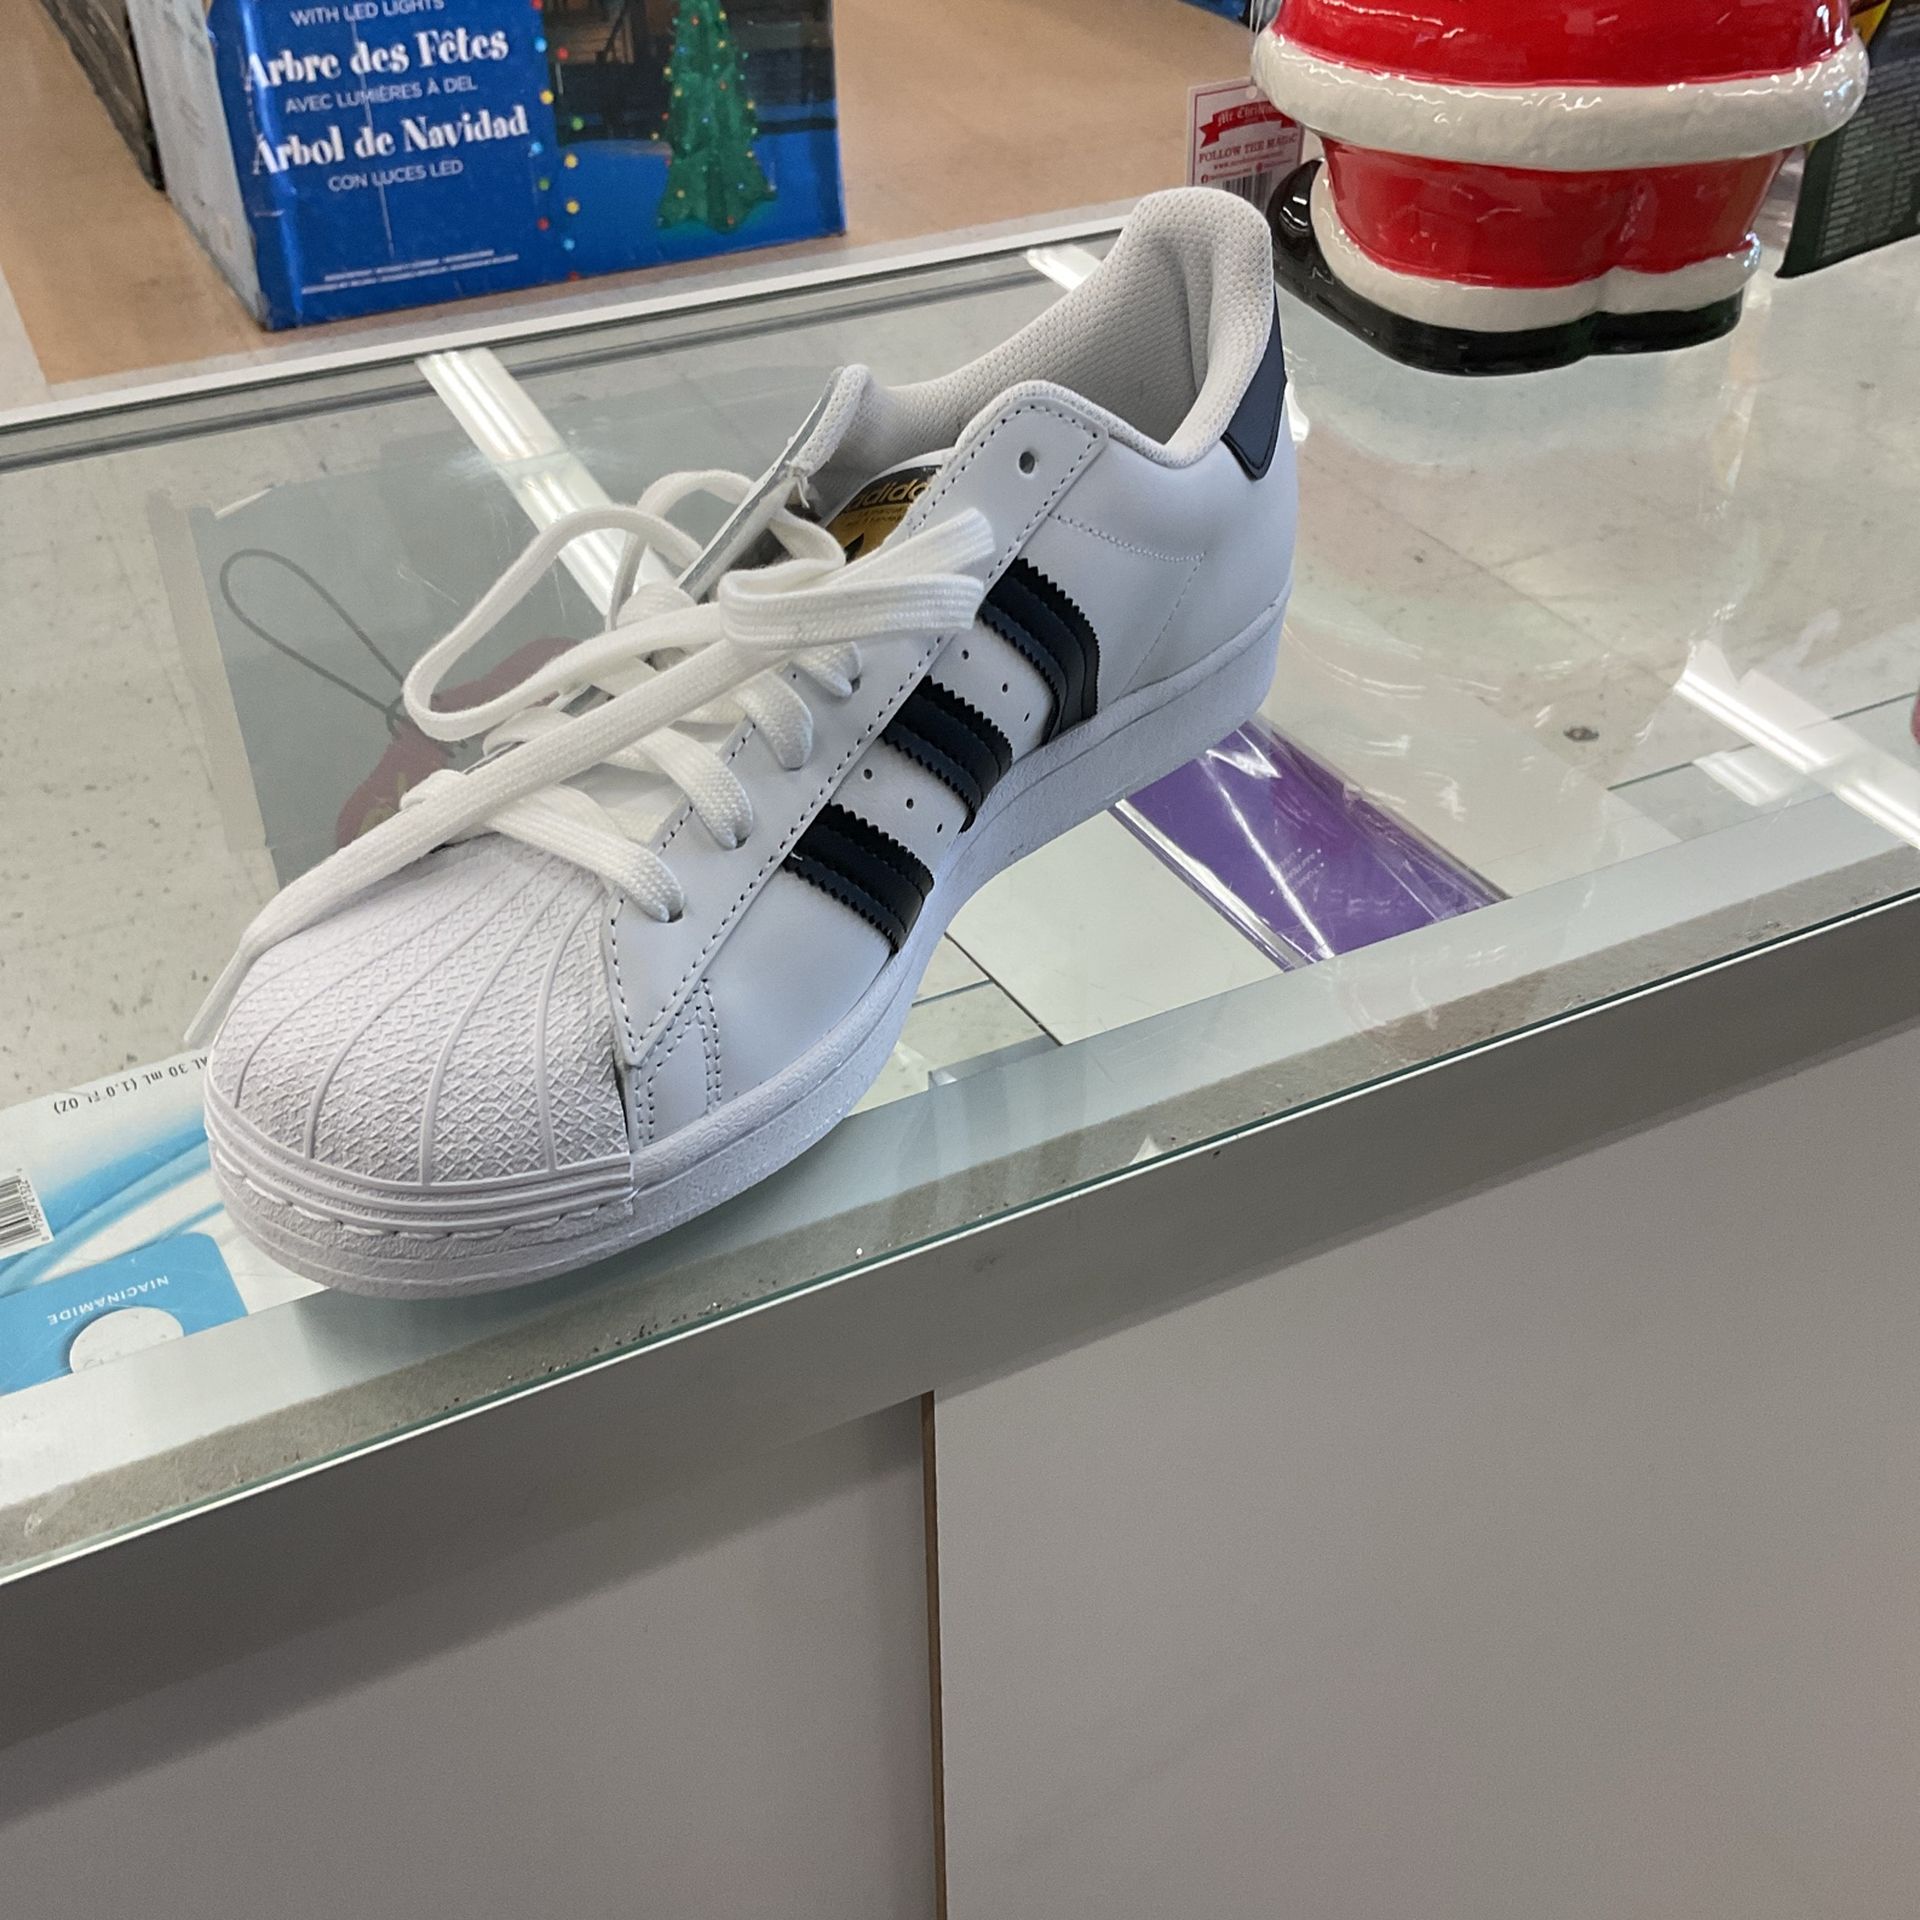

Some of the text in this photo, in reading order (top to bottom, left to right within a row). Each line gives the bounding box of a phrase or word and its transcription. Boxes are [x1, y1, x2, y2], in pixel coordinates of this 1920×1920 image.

[290, 0, 445, 27] WITH LED LIGHTS
[244, 27, 509, 92] Arbre des Fêtes
[285, 93, 334, 113] AVEC
[427, 76, 440, 95] À
[443, 76, 478, 93] DEL
[354, 126, 396, 158] de
[401, 105, 529, 151] Navidad
[1199, 145, 1242, 163] FOLLOW
[1244, 140, 1265, 154] THE
[328, 159, 464, 192] CON LUCES LED
[143, 1070, 163, 1085] mL
[168, 1063, 188, 1078] 30
[106, 1077, 138, 1098] (1.0
[53, 1097, 79, 1114] OZ)
[47, 1275, 169, 1326] NIACINAMIDE
